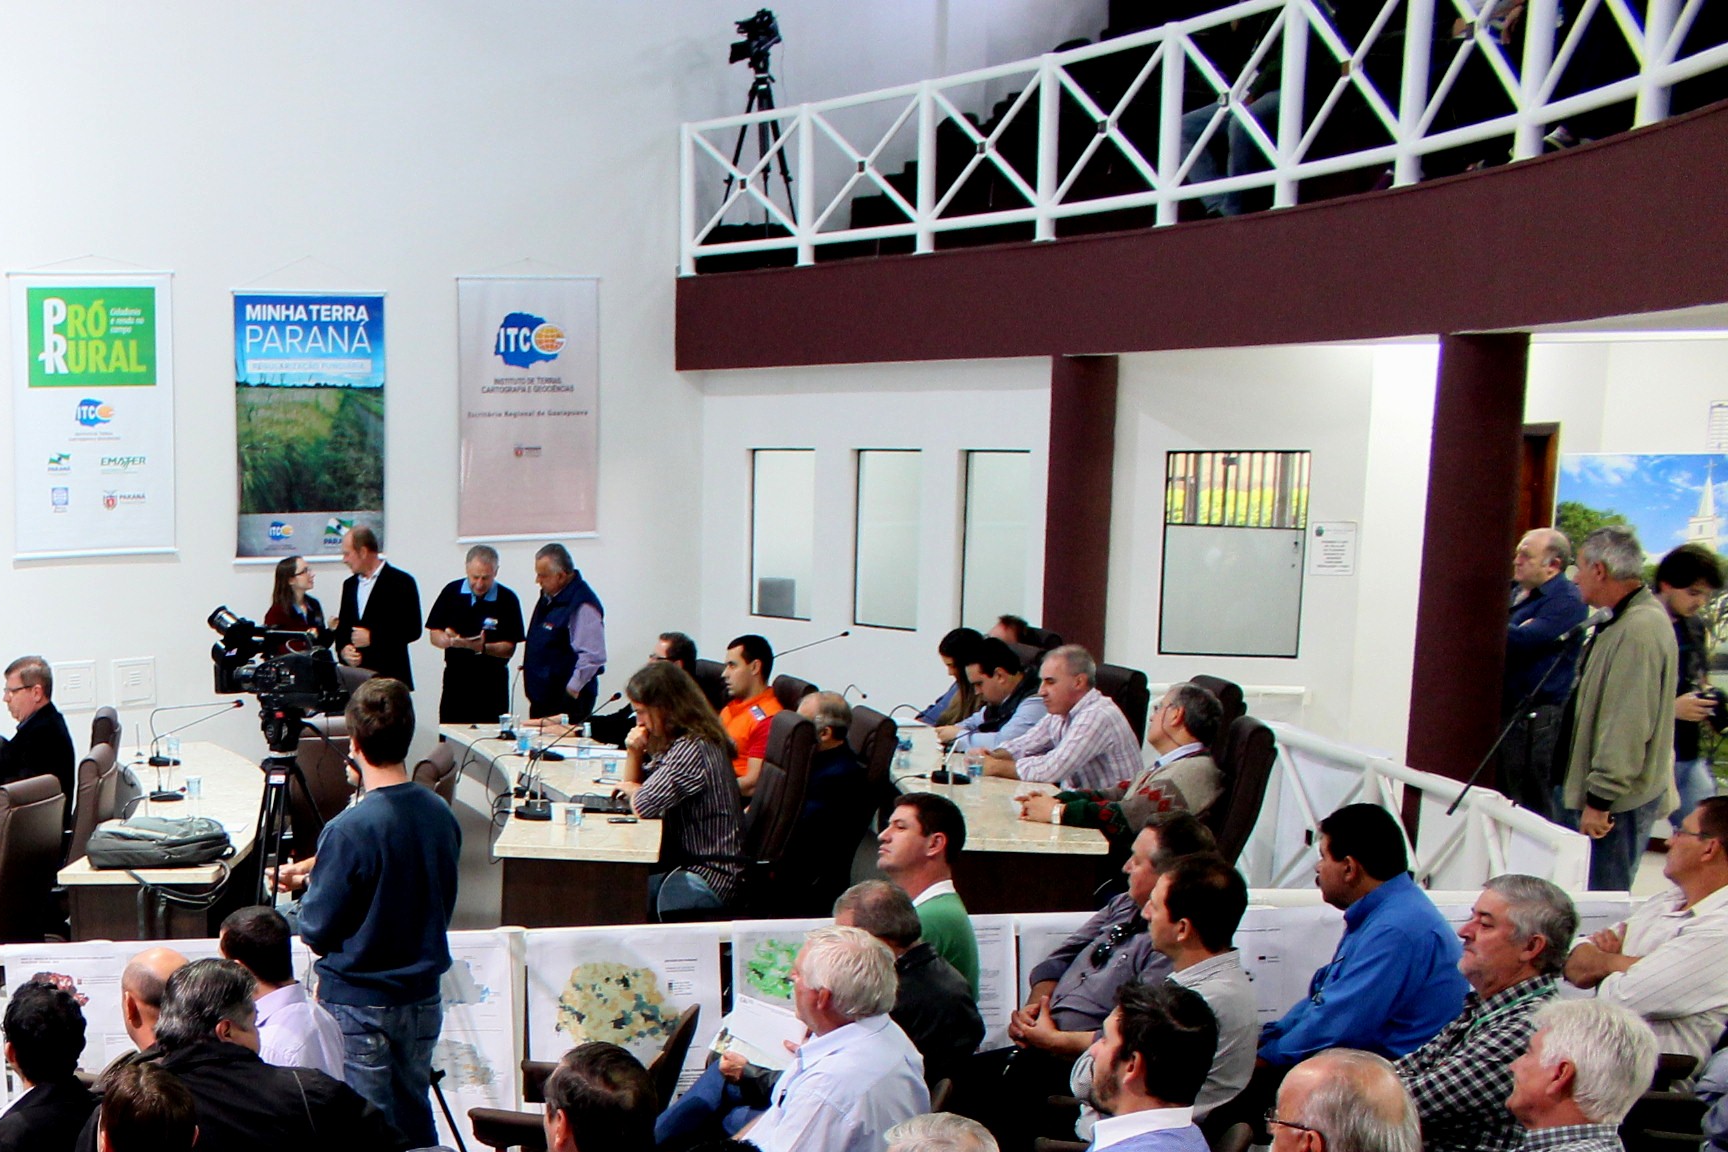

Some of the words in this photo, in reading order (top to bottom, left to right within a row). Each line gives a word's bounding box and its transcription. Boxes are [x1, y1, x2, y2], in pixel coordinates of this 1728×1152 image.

[110, 307, 142, 316] Cidadania
[245, 304, 307, 322] MINHA
[309, 304, 370, 322] TERRA
[42, 296, 107, 338] PRÓ
[110, 326, 132, 335] campo
[245, 318, 372, 354] PARANÁ
[38, 333, 147, 374] RURAL
[493, 377, 526, 385] INSTITUTO
[481, 385, 526, 394] CARTOGRAFIA
[533, 384, 575, 393] GEOCIÊNCIAS
[504, 410, 535, 418] Regional
